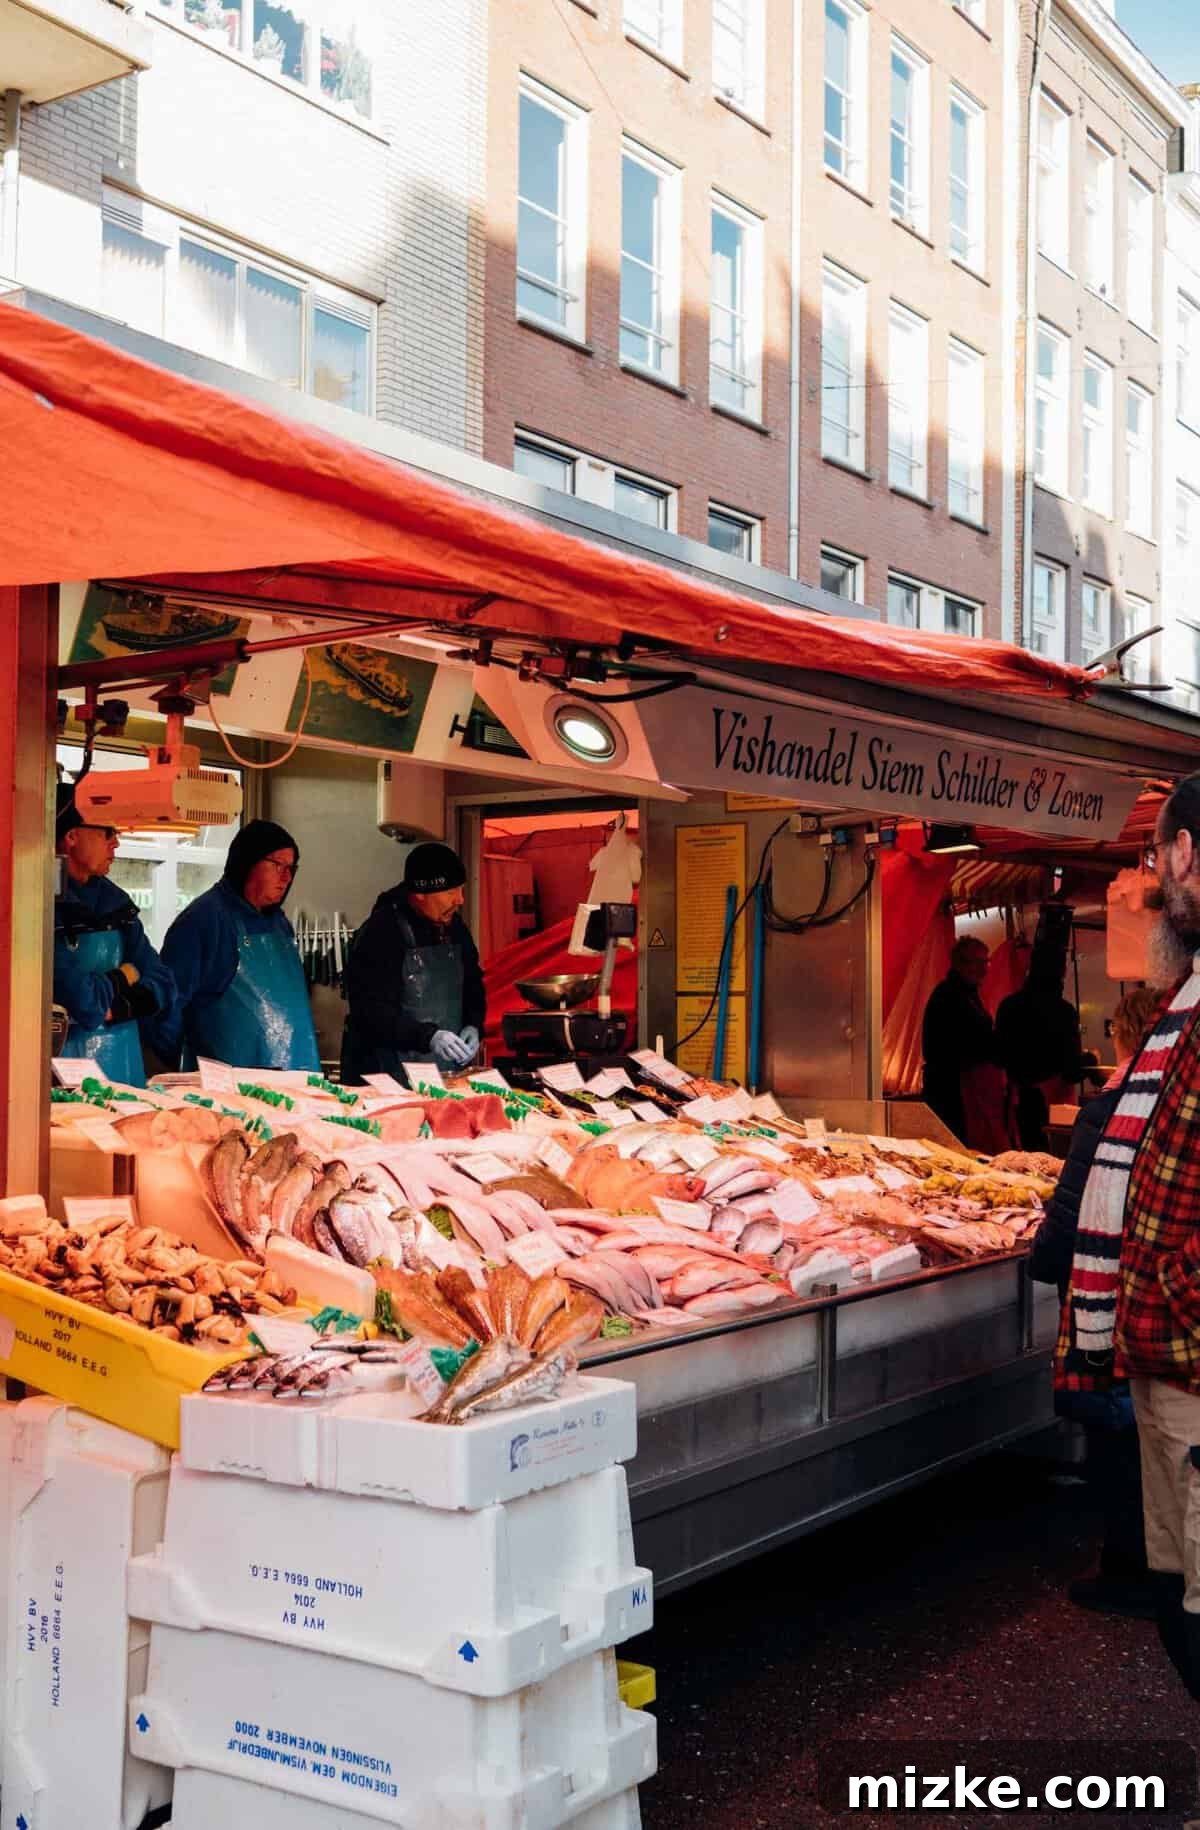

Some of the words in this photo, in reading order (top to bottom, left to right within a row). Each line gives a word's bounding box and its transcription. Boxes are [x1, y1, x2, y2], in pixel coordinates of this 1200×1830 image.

[713, 707, 857, 786] Vishandel
[862, 736, 924, 796] Siem
[931, 750, 1019, 809] Schilder
[1024, 767, 1047, 812] &
[1048, 772, 1104, 822] Zonen
[44, 1308, 65, 1323] HVY
[68, 1317, 81, 1330] BV
[53, 1329, 71, 1343] 2017
[284, 1571, 309, 1588] 6664
[315, 1577, 363, 1599] HOLLAND
[28, 1598, 37, 1616] BV
[294, 1593, 316, 1608] 2014
[282, 1610, 297, 1625] BV
[303, 1615, 325, 1630] HVY
[28, 1624, 36, 1651] HVY
[52, 1647, 61, 1707] HOLLAND
[235, 1720, 260, 1737] 2000
[267, 1728, 327, 1756] NOVEMBER
[227, 1737, 307, 1770] VISMIJNBEDRIJF
[331, 1746, 392, 1776] VLISSINGEN
[341, 1770, 398, 1797] EIGENDOM
